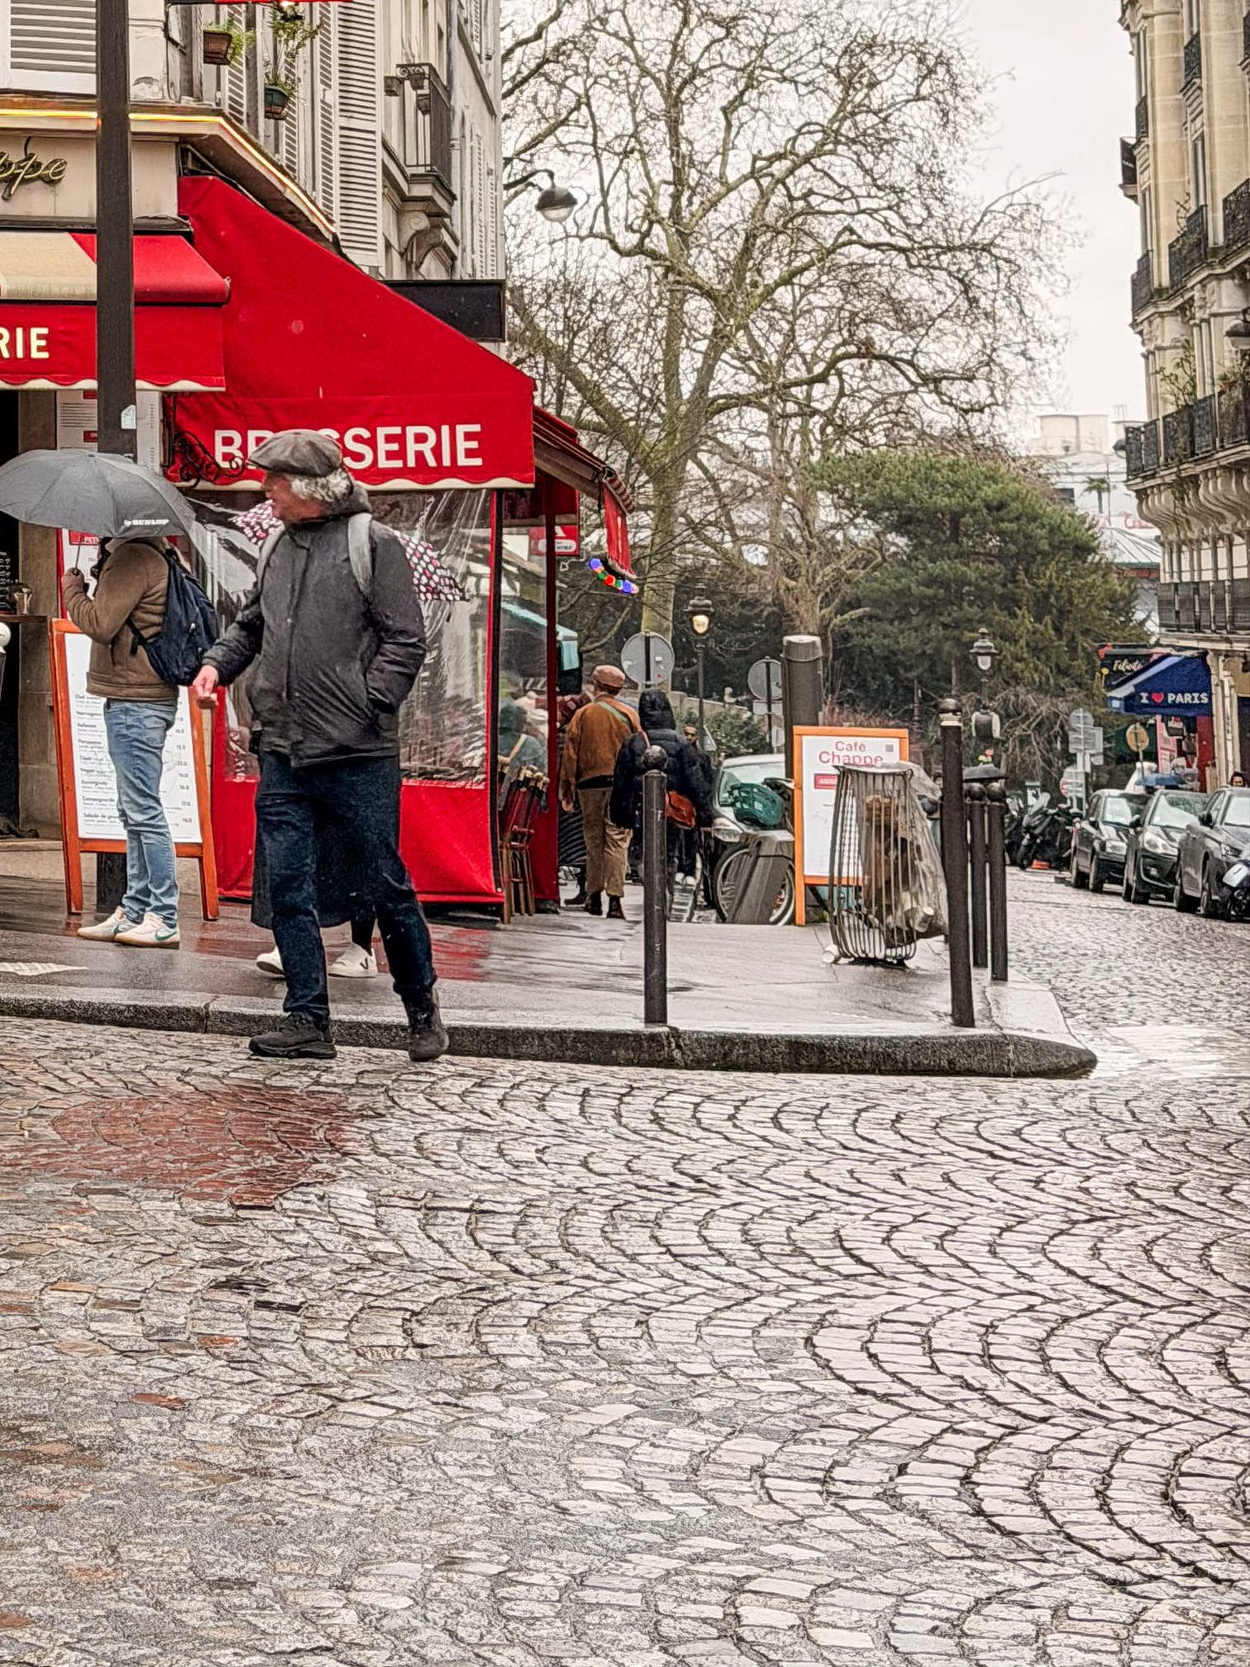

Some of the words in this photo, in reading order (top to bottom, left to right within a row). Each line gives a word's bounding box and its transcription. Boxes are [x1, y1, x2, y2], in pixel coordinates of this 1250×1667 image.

[214, 424, 483, 469] BRSERIE
[1139, 692, 1150, 704] I
[1167, 692, 1209, 704] PARIS
